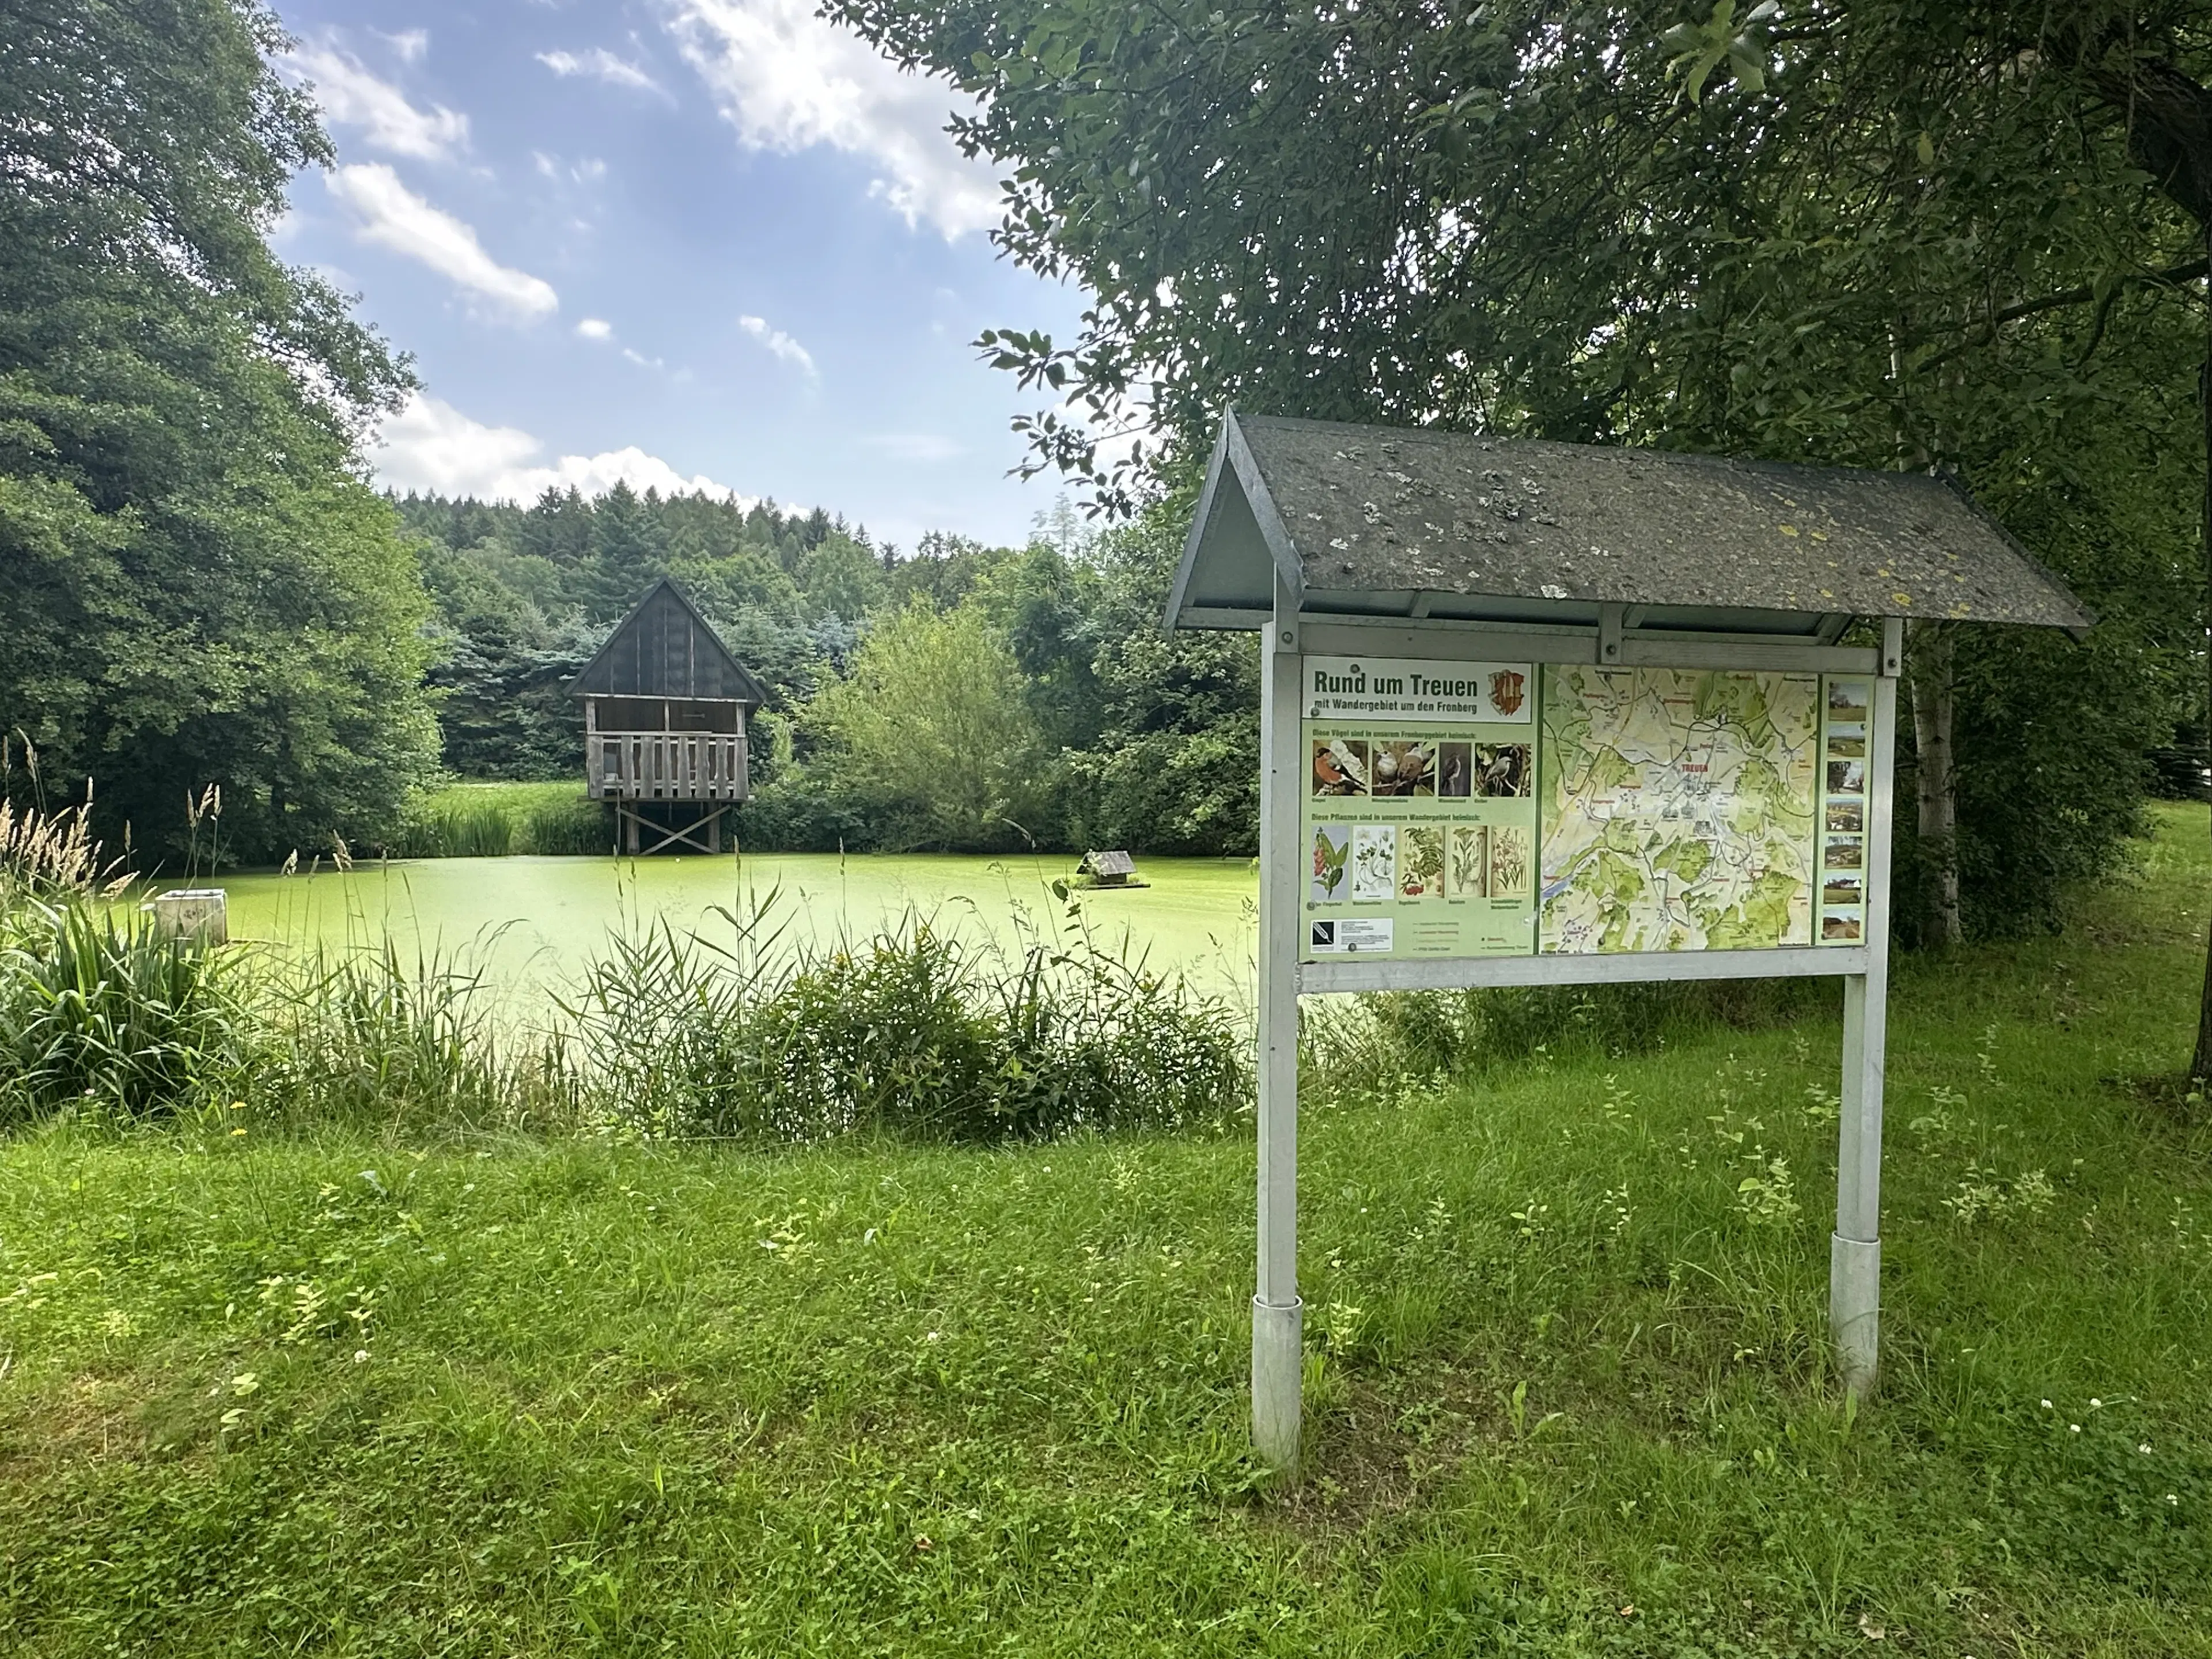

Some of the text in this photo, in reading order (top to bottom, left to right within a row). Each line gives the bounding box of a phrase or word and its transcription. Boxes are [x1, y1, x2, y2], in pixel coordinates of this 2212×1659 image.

[1315, 671, 1478, 696] Rund um Treuen
[1315, 698, 1477, 714] mit Wandergebiet um den Fronberg
[1682, 764, 1708, 772] TREUEN
